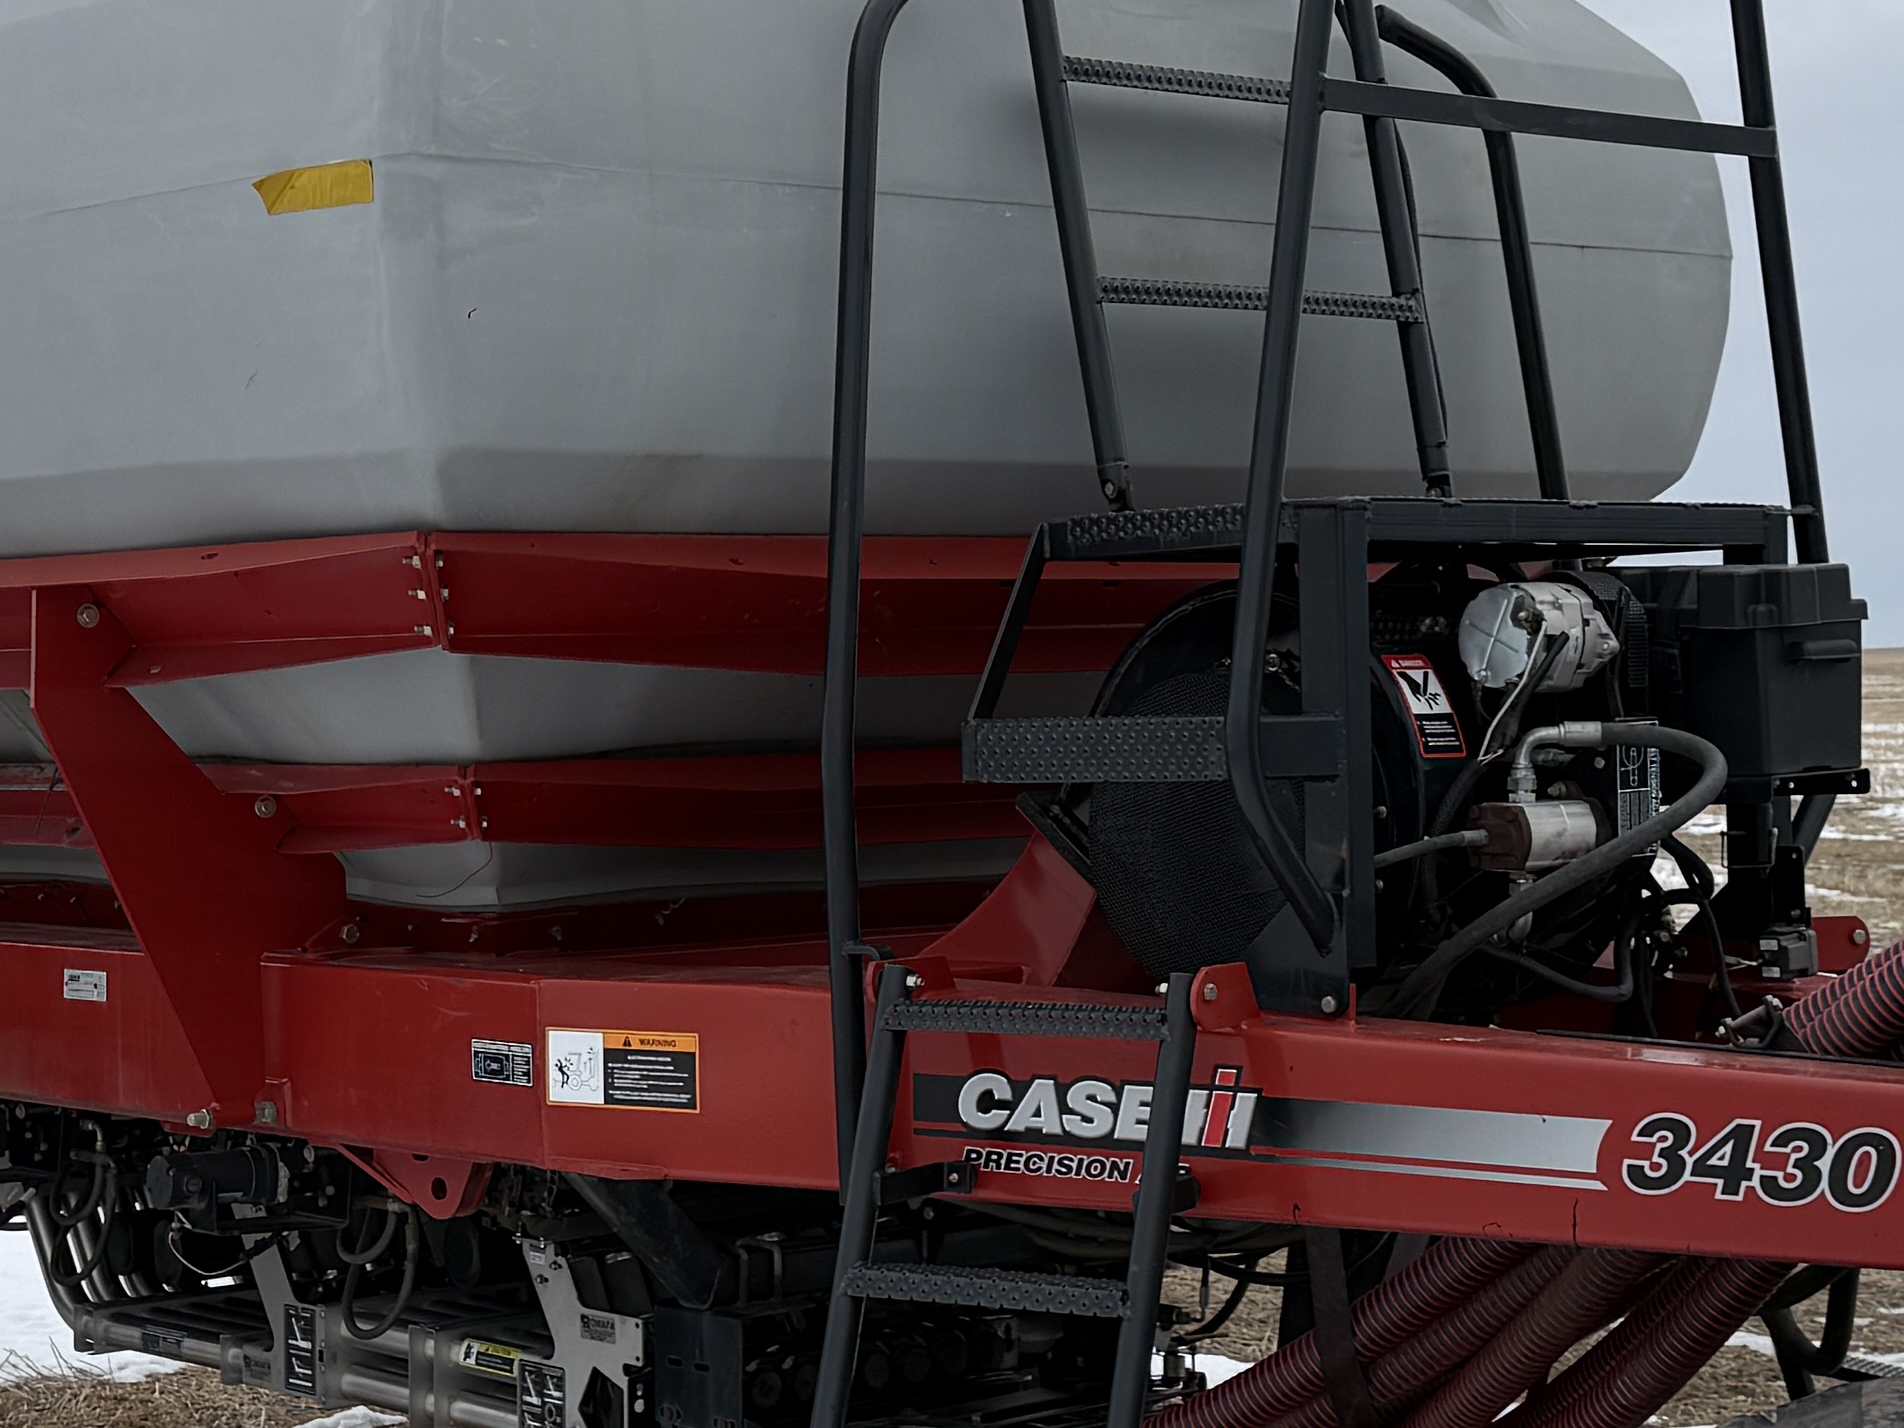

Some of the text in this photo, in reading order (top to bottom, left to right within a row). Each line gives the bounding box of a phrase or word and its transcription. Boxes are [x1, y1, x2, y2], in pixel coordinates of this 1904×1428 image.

[639, 1038, 677, 1048] WARNING
[958, 1072, 1153, 1140] CASE
[963, 1147, 1134, 1183] PRECISION
[1622, 1112, 1902, 1213] 3430
